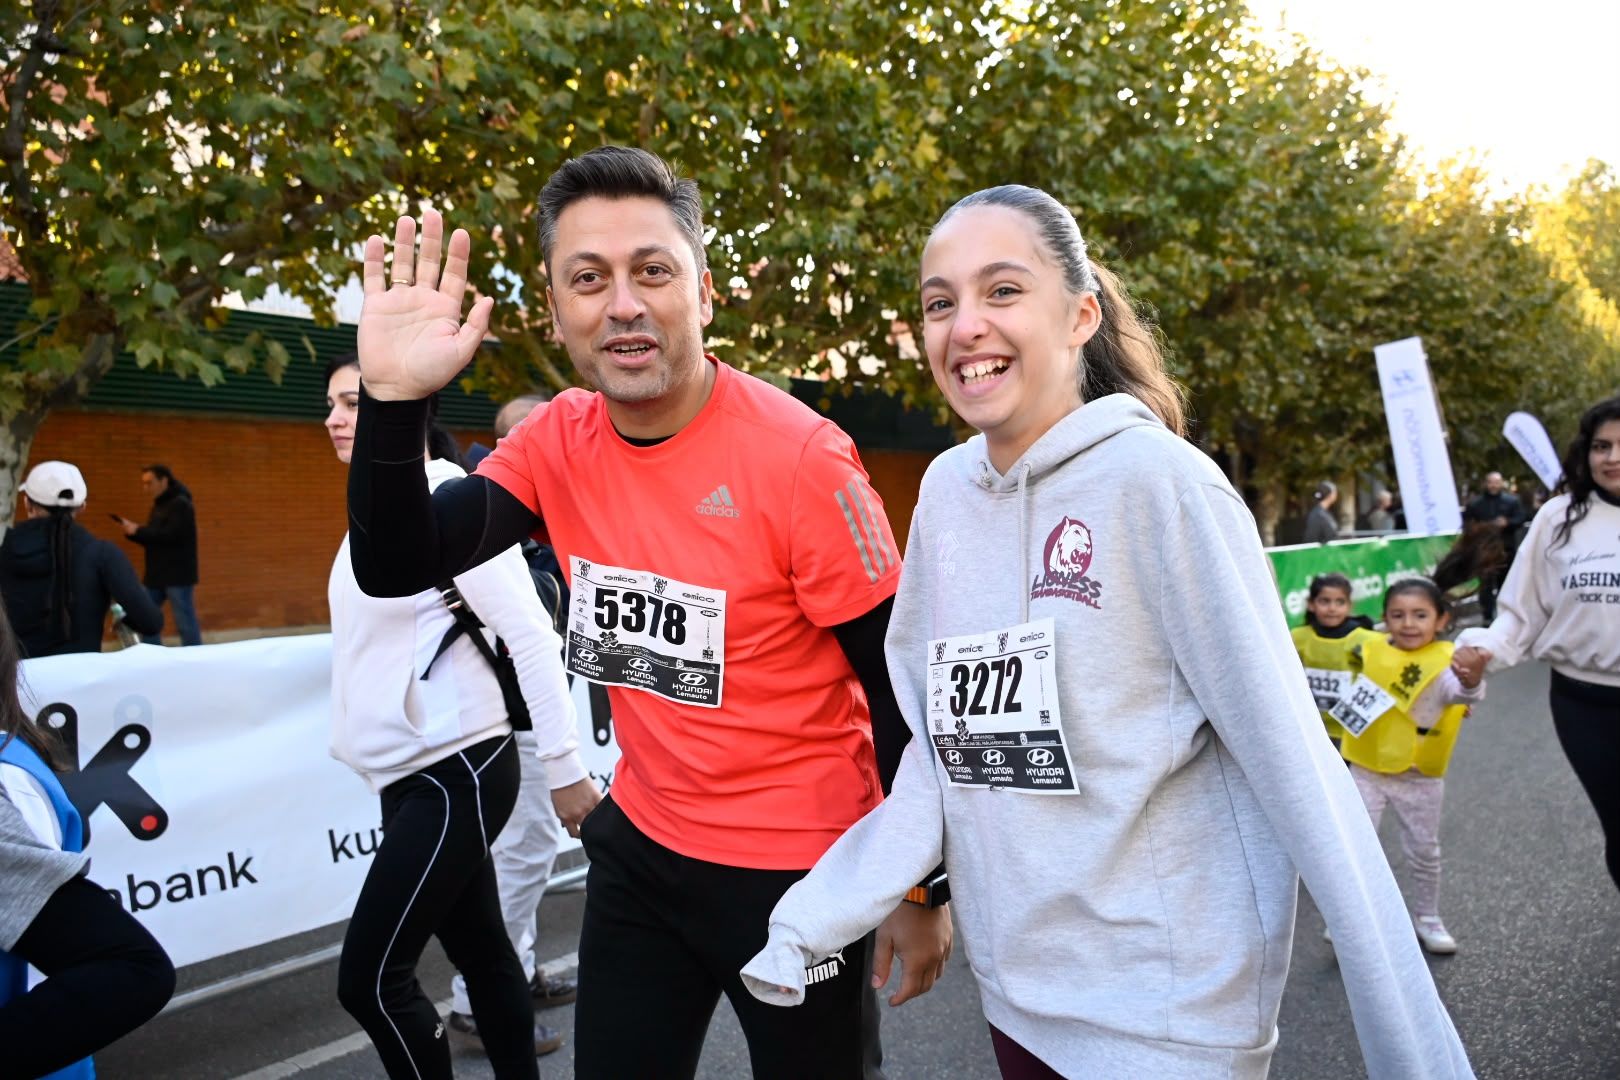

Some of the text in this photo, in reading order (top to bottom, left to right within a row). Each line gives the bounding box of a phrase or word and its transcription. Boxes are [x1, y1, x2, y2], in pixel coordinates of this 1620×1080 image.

[695, 503, 740, 518] adidas
[604, 574, 637, 583] emico
[682, 592, 715, 603] emico
[594, 587, 687, 646] 5378
[1019, 632, 1045, 643] emico
[571, 657, 604, 673] HYUNDAI
[574, 664, 600, 677] Lemauto
[621, 669, 658, 683] HYUNDAI
[672, 682, 713, 695] HYUNDAI
[949, 656, 1023, 717] 3272
[676, 690, 708, 700] Lemauto
[946, 765, 973, 774] HYUNDAI
[981, 766, 1015, 775] HYUNDAI
[1025, 767, 1065, 776] HYUNDAI
[988, 775, 1013, 783] Lemauto
[1031, 777, 1062, 785] Lemauto
[328, 828, 384, 863] ku
[805, 960, 839, 986] UMA
